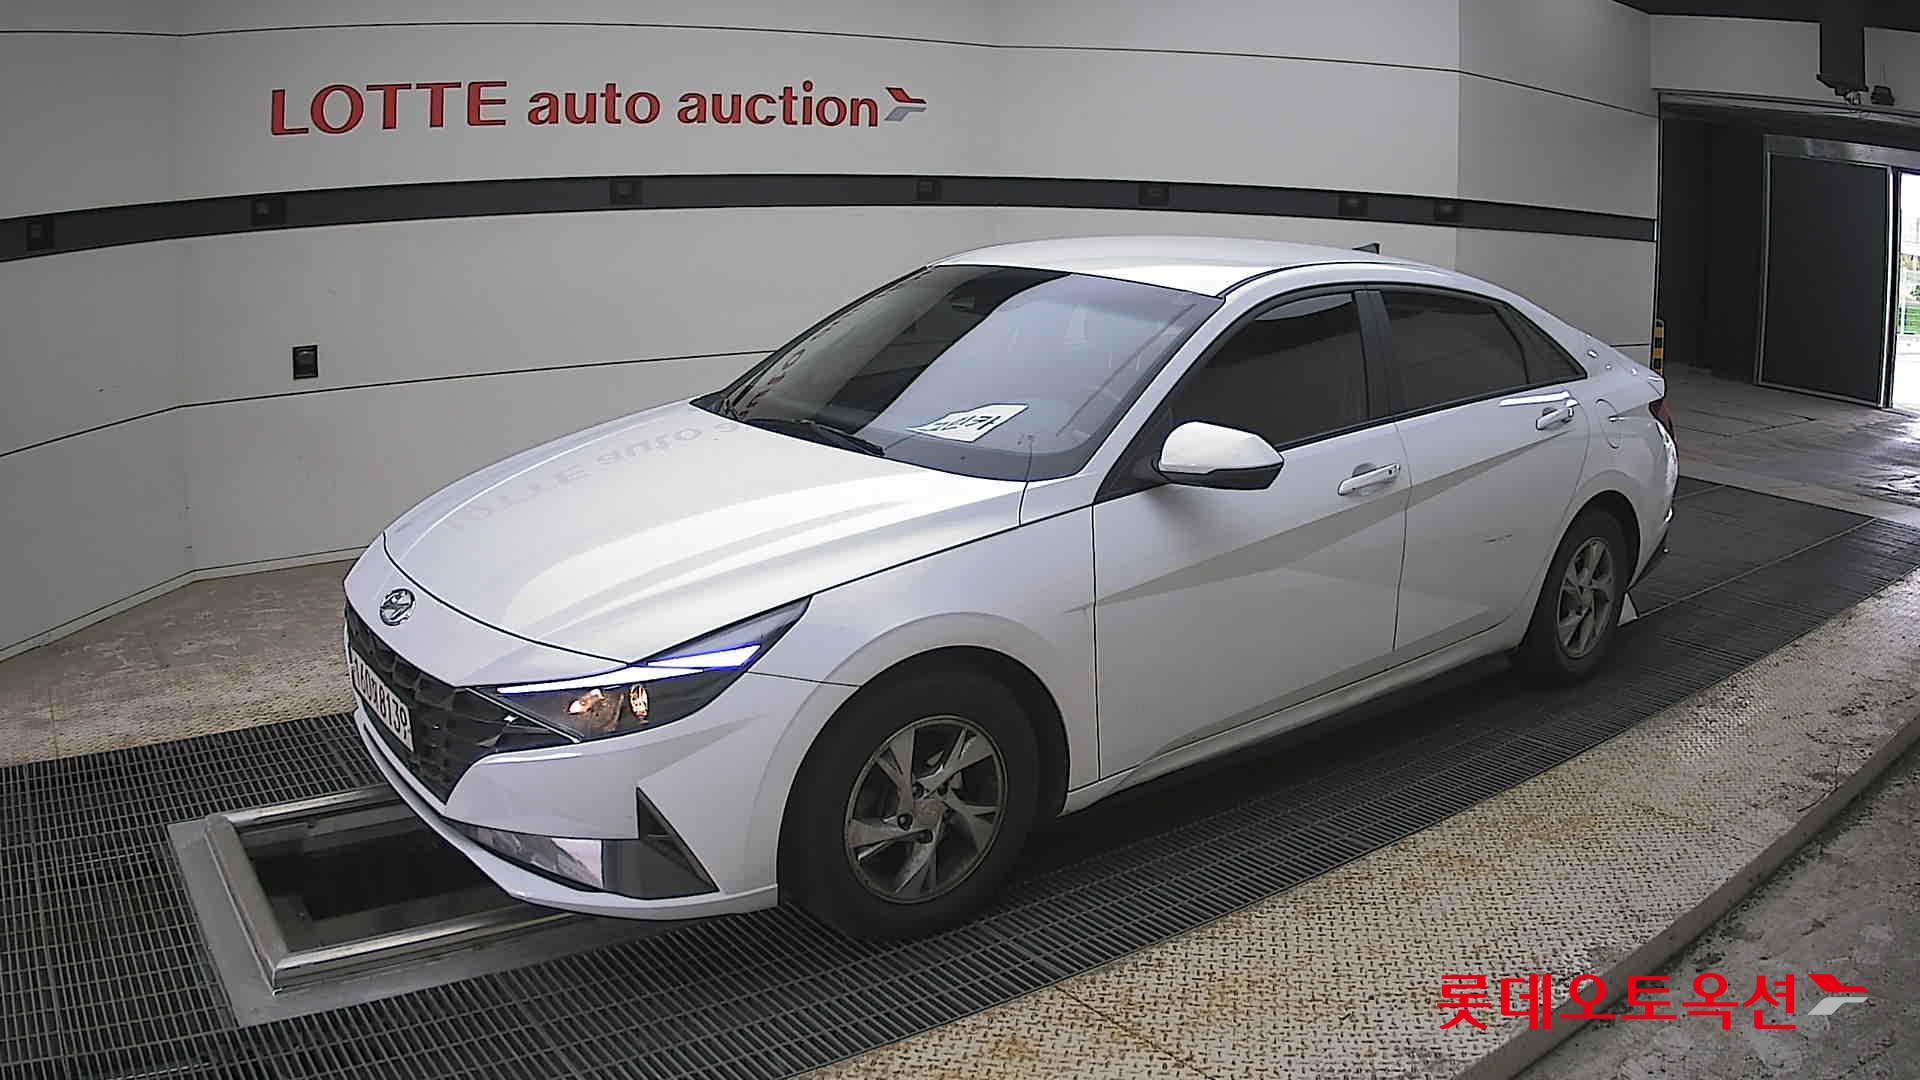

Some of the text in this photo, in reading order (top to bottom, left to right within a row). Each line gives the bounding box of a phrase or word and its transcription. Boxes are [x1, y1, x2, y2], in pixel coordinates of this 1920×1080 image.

[271, 80, 879, 136] LOTTE auto auction
